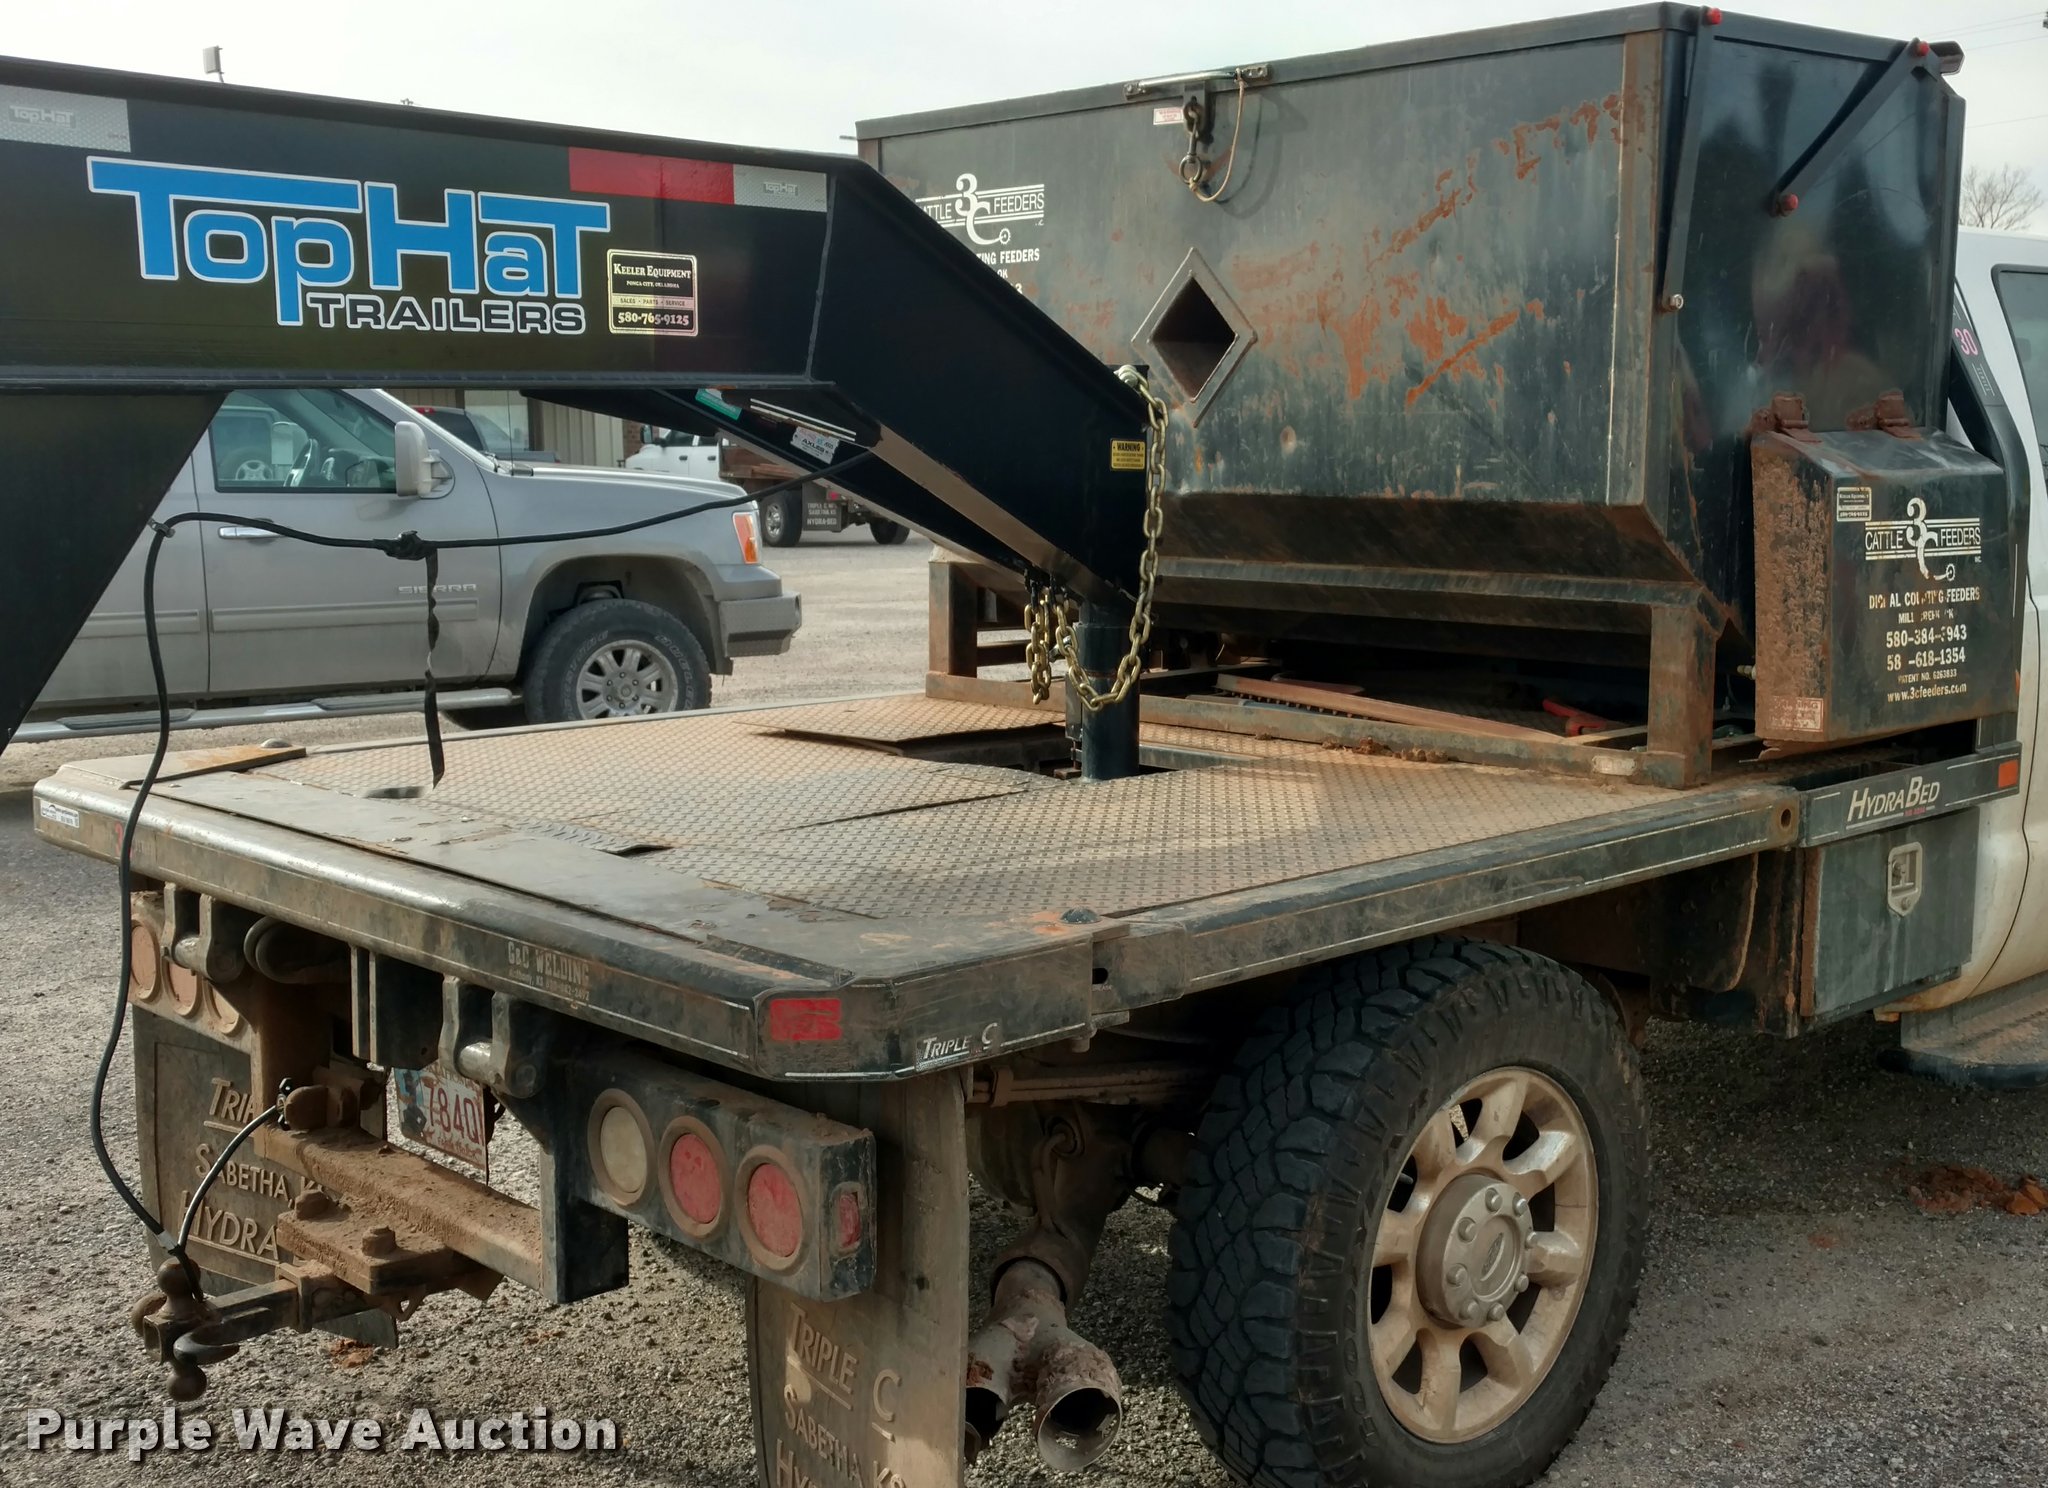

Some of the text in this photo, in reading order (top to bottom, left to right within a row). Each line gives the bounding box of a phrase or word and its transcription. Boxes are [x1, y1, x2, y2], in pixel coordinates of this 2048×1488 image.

[922, 198, 952, 222] TTLE
[993, 192, 1045, 213] FEEDERS
[1000, 248, 1040, 264] FEEDERS
[646, 265, 692, 279] EQUIPMENT
[305, 292, 586, 336] TRAILERS
[618, 311, 690, 326] 580-765-9125
[1865, 530, 1904, 551] CATTLE
[1940, 526, 1982, 547] FEEDERS
[1945, 586, 1980, 603] FEEDERS
[1887, 646, 1966, 671] 58-618-1354
[535, 948, 589, 986] WELDING
[922, 1034, 973, 1060] TRIPLE
[787, 1302, 902, 1423] TRIPLE C
